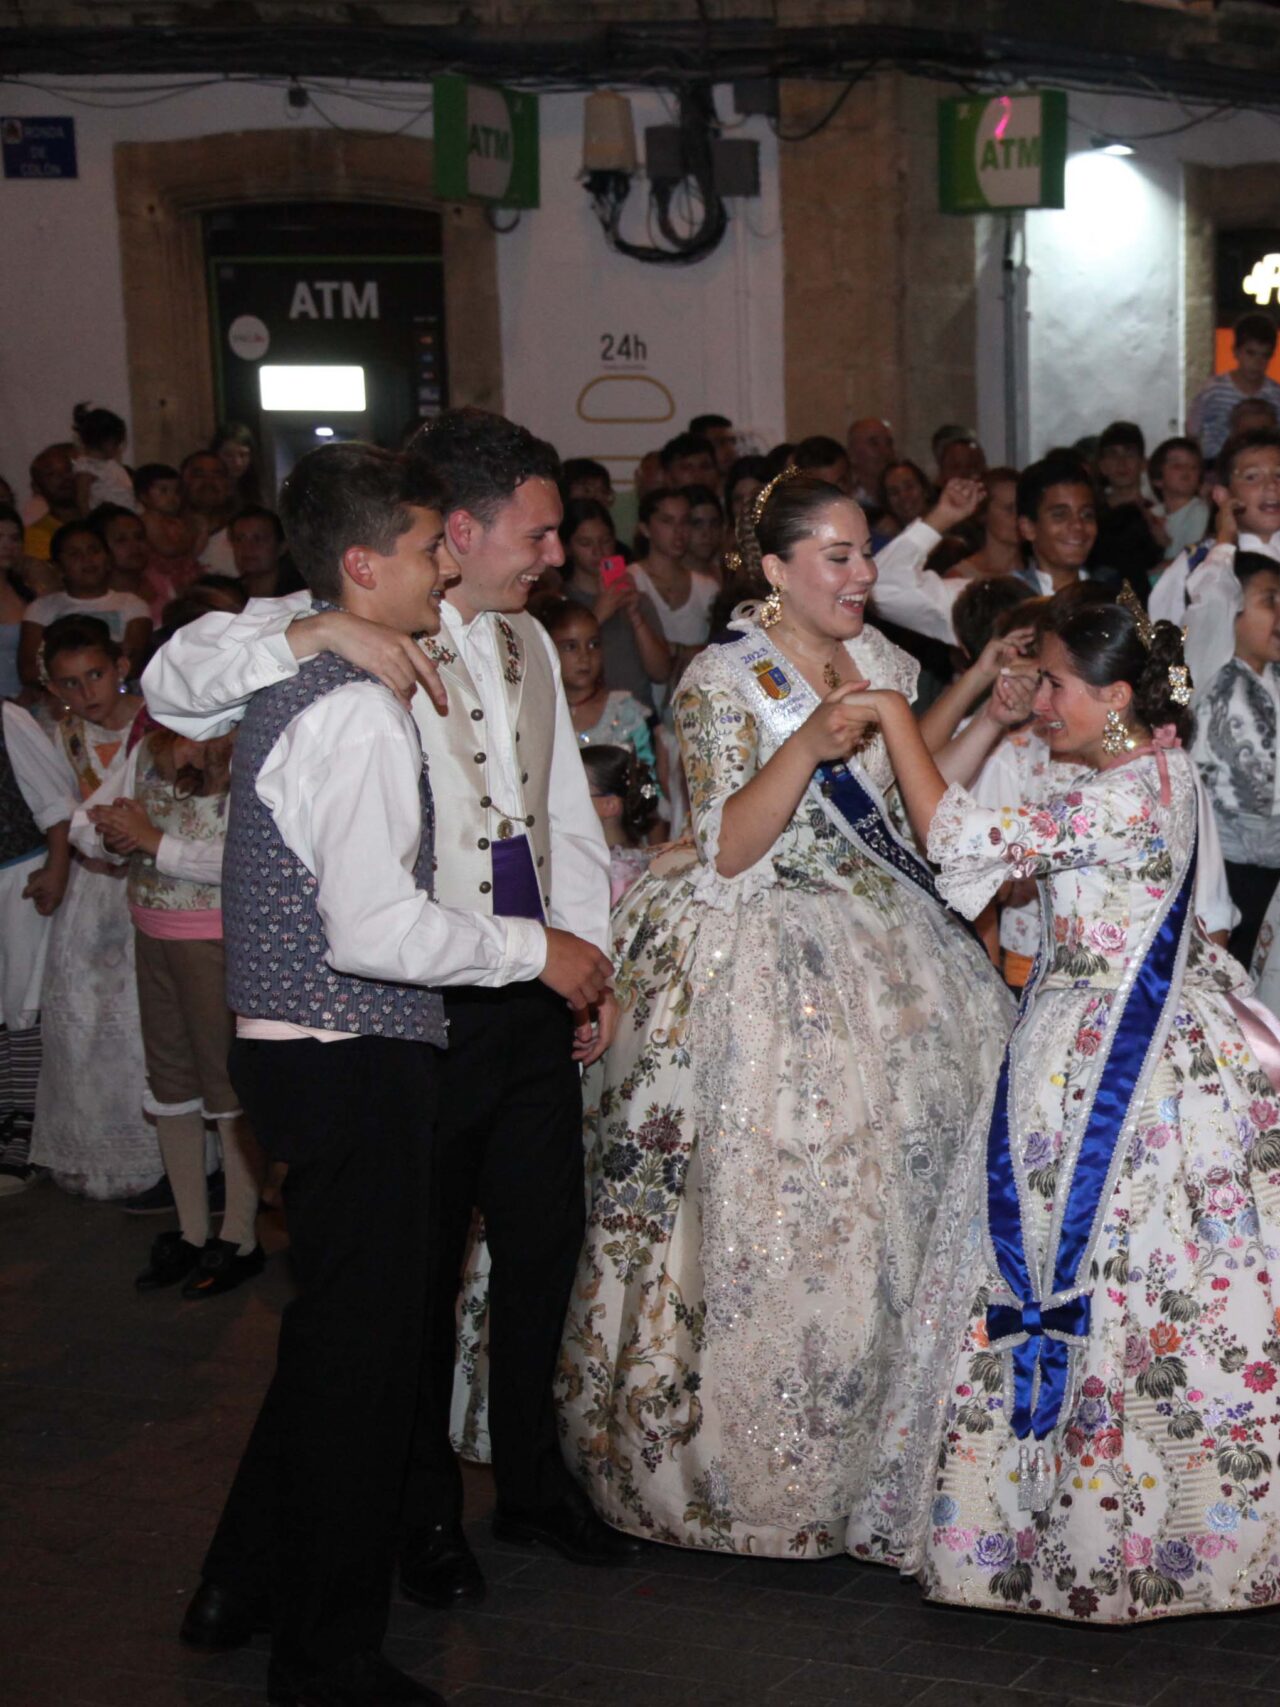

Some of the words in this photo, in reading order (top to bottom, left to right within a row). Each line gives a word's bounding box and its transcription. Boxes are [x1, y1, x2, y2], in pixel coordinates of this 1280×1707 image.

[469, 124, 509, 162] ATM
[980, 137, 1041, 169] ATM
[289, 281, 379, 319] ATM
[600, 332, 647, 361] 24h
[741, 647, 769, 665] 2023
